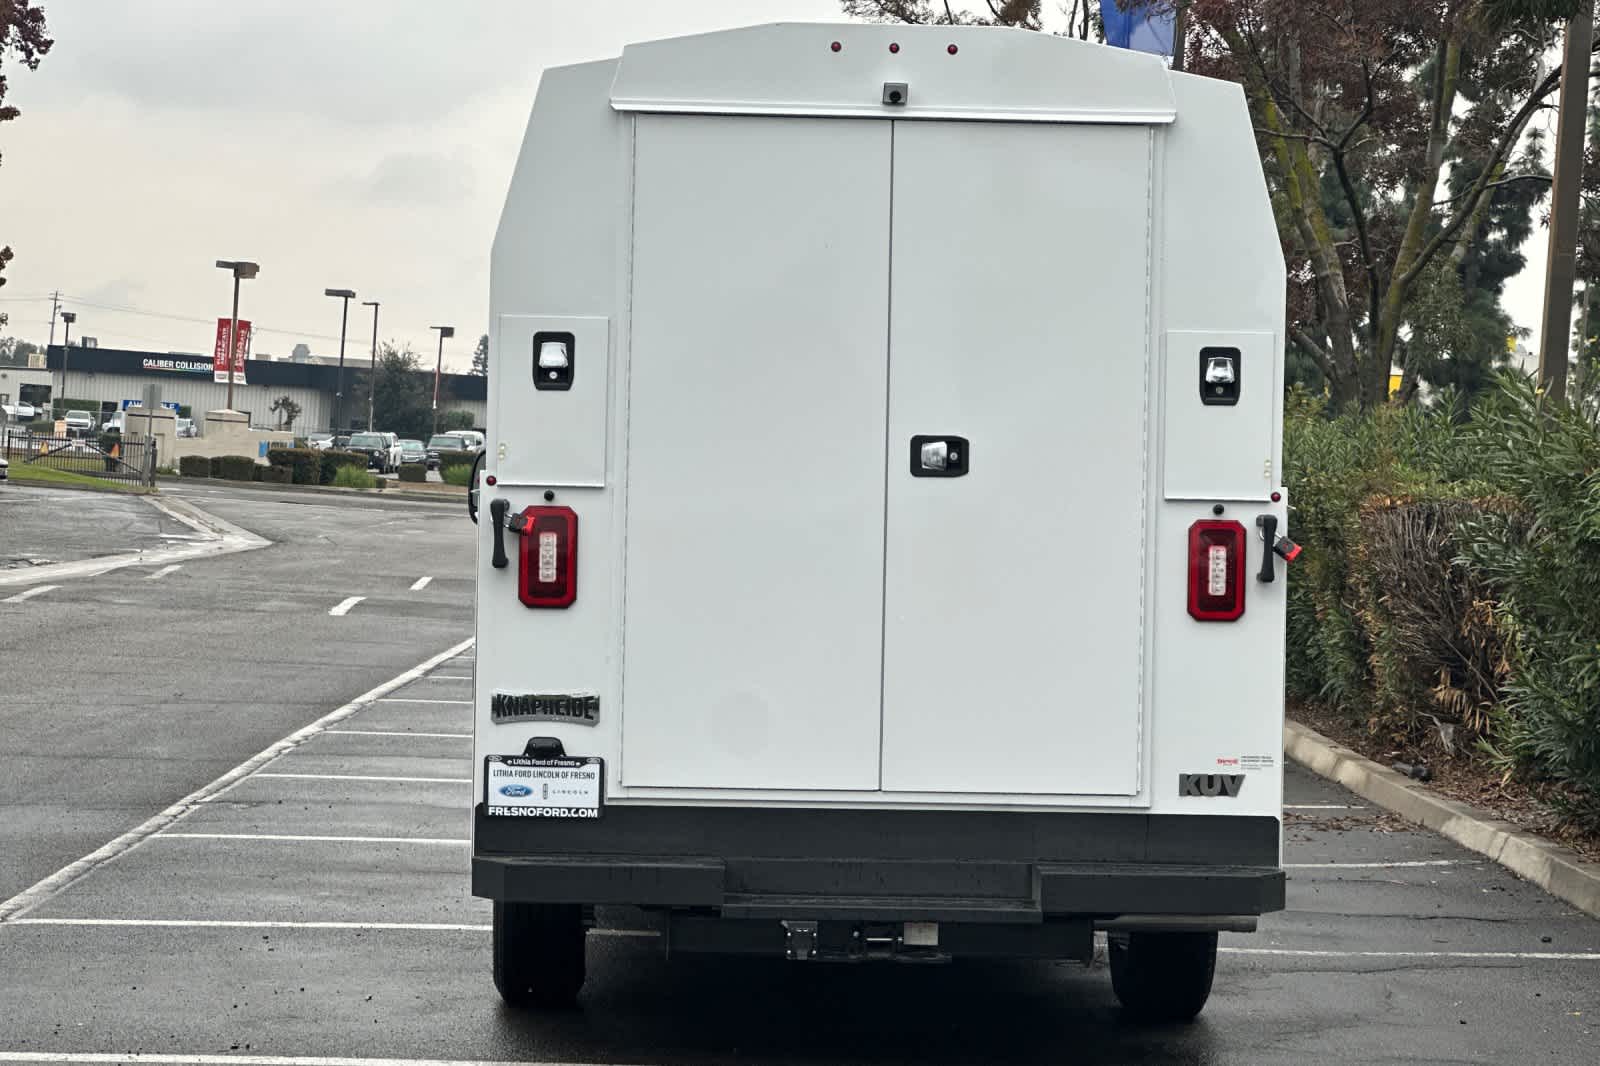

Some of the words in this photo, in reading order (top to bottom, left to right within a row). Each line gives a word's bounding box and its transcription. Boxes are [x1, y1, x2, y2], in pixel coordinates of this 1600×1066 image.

[143, 359, 173, 368] CALIBER
[175, 361, 213, 371] COLLISION
[495, 694, 594, 720] KNAPHEIDE
[493, 769, 513, 777] LITHIA
[515, 770, 531, 778] FORD
[533, 770, 560, 779] LINCOLN
[1178, 773, 1246, 797] KUV
[488, 806, 598, 818] FRESNOFORD.COM
